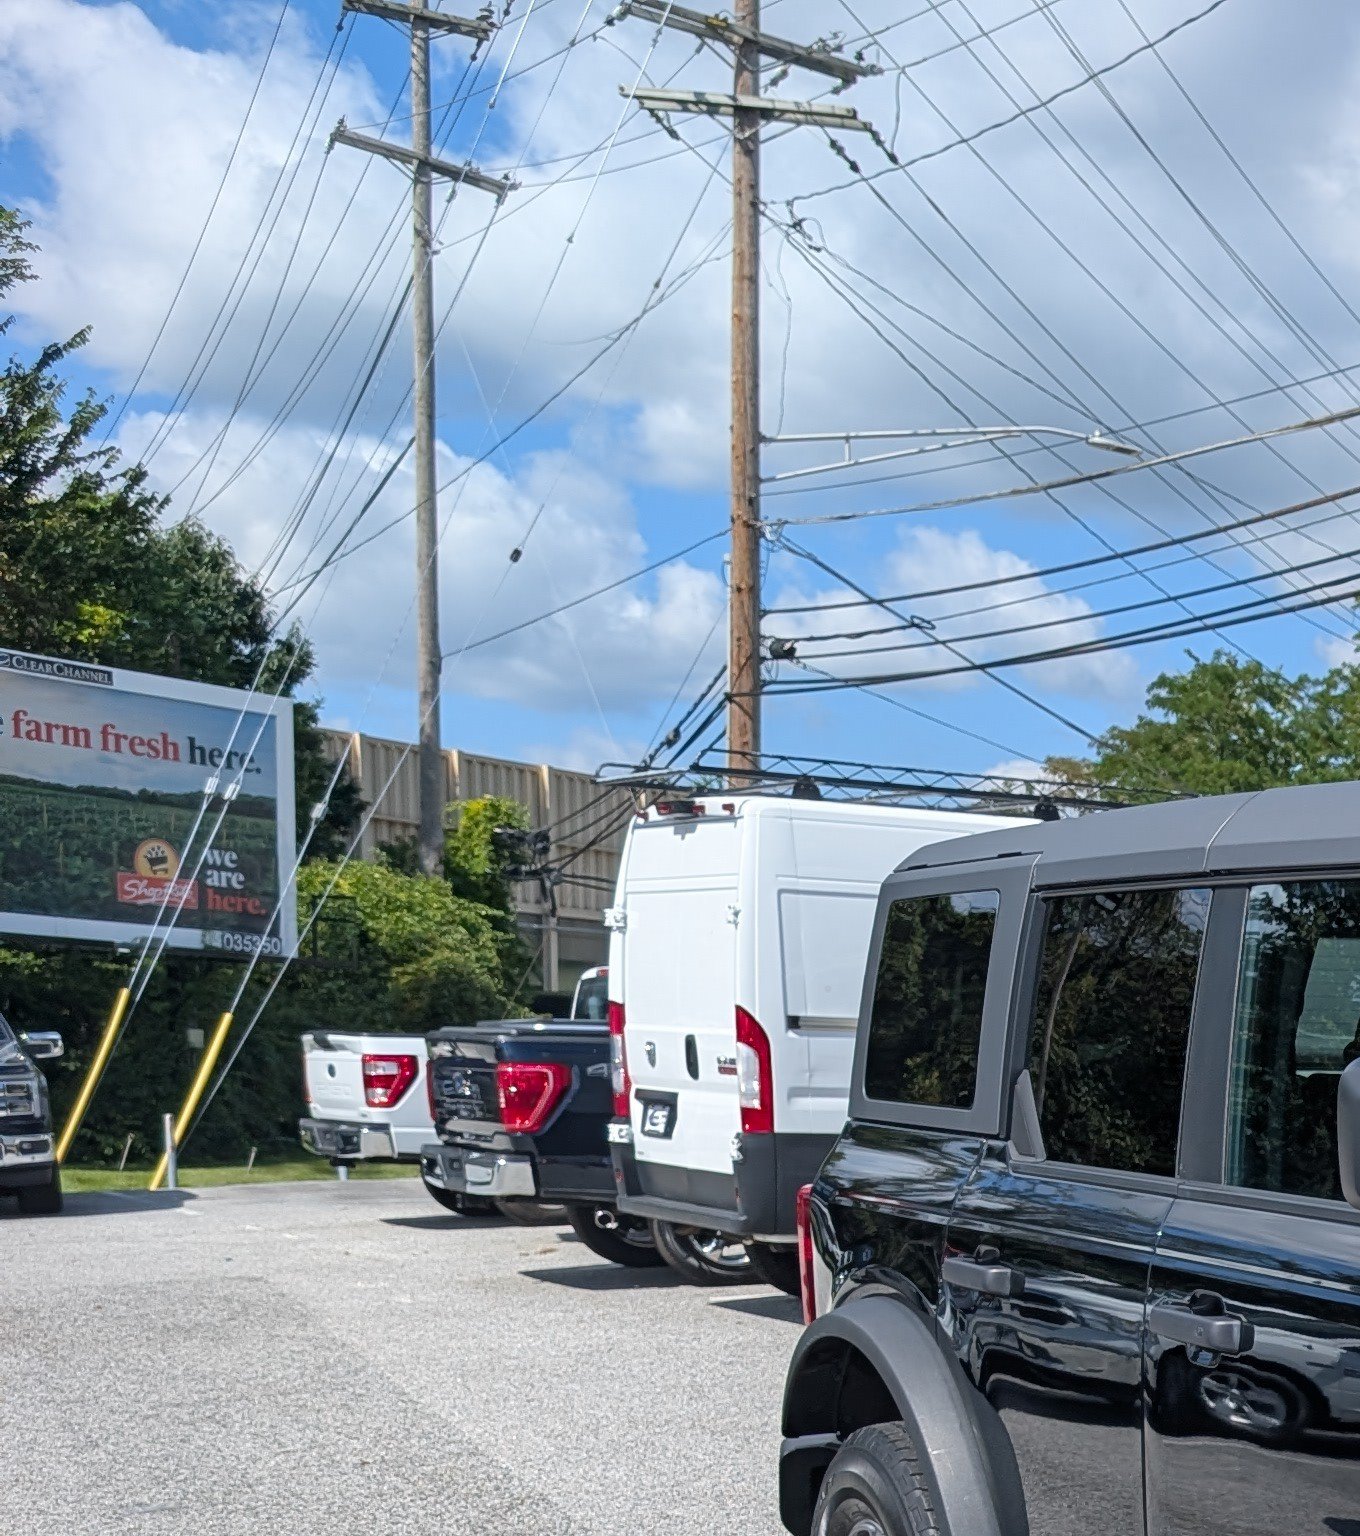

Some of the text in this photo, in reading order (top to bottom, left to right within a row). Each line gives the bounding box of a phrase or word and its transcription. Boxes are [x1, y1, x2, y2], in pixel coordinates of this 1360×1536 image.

[11, 709, 93, 749] farm
[100, 722, 181, 763] fresh
[187, 735, 262, 774] here.
[205, 848, 239, 868] we
[205, 868, 246, 890] are
[205, 887, 269, 915] here.
